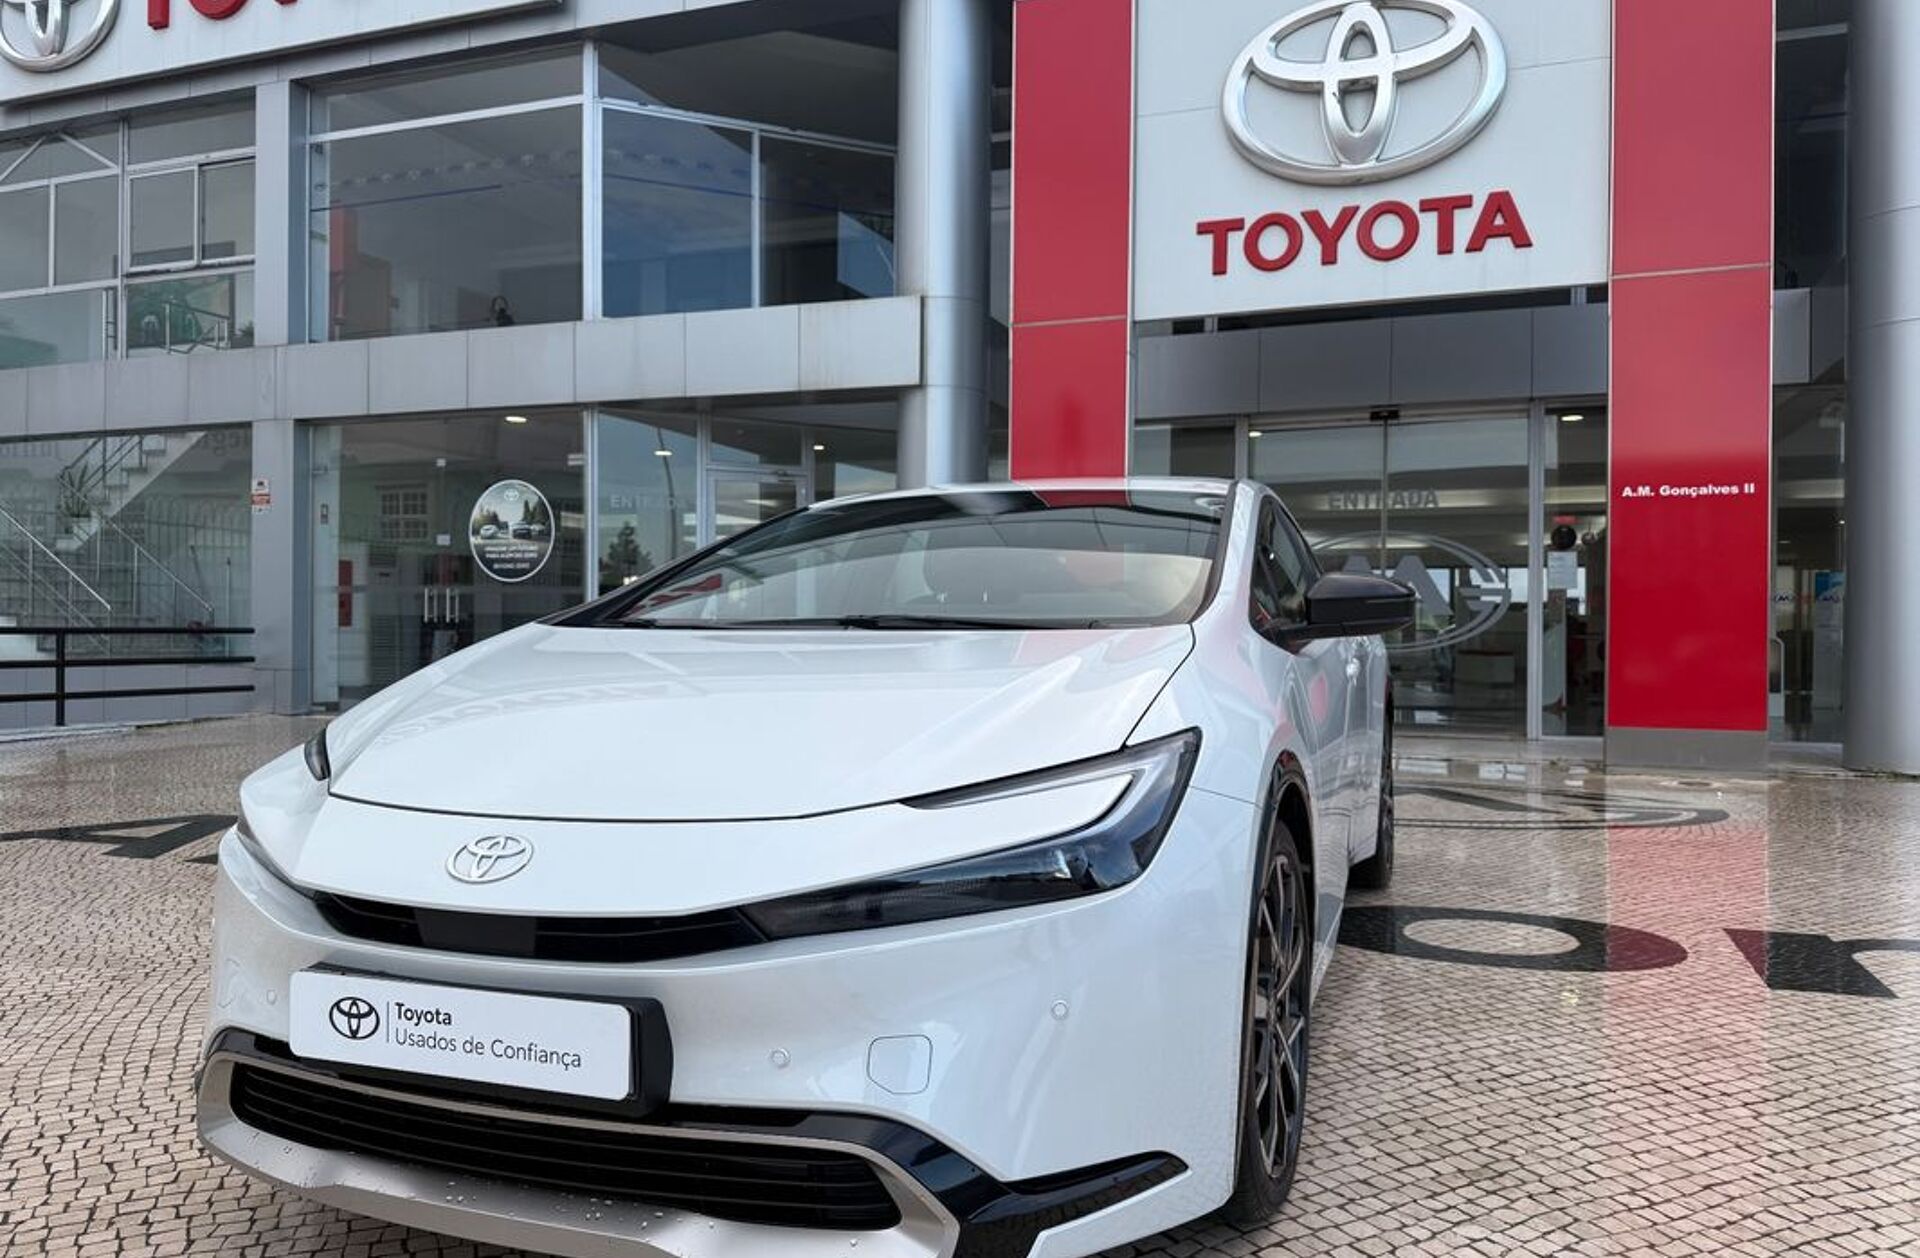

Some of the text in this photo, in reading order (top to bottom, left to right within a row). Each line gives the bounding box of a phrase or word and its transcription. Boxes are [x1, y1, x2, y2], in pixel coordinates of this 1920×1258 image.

[1196, 190, 1534, 276] TOYOTA
[1621, 486, 1655, 497] A.M.
[1659, 483, 1739, 498] Gonçalves
[394, 1001, 453, 1027] Toyota
[394, 1026, 582, 1071] Usados de Confiança
